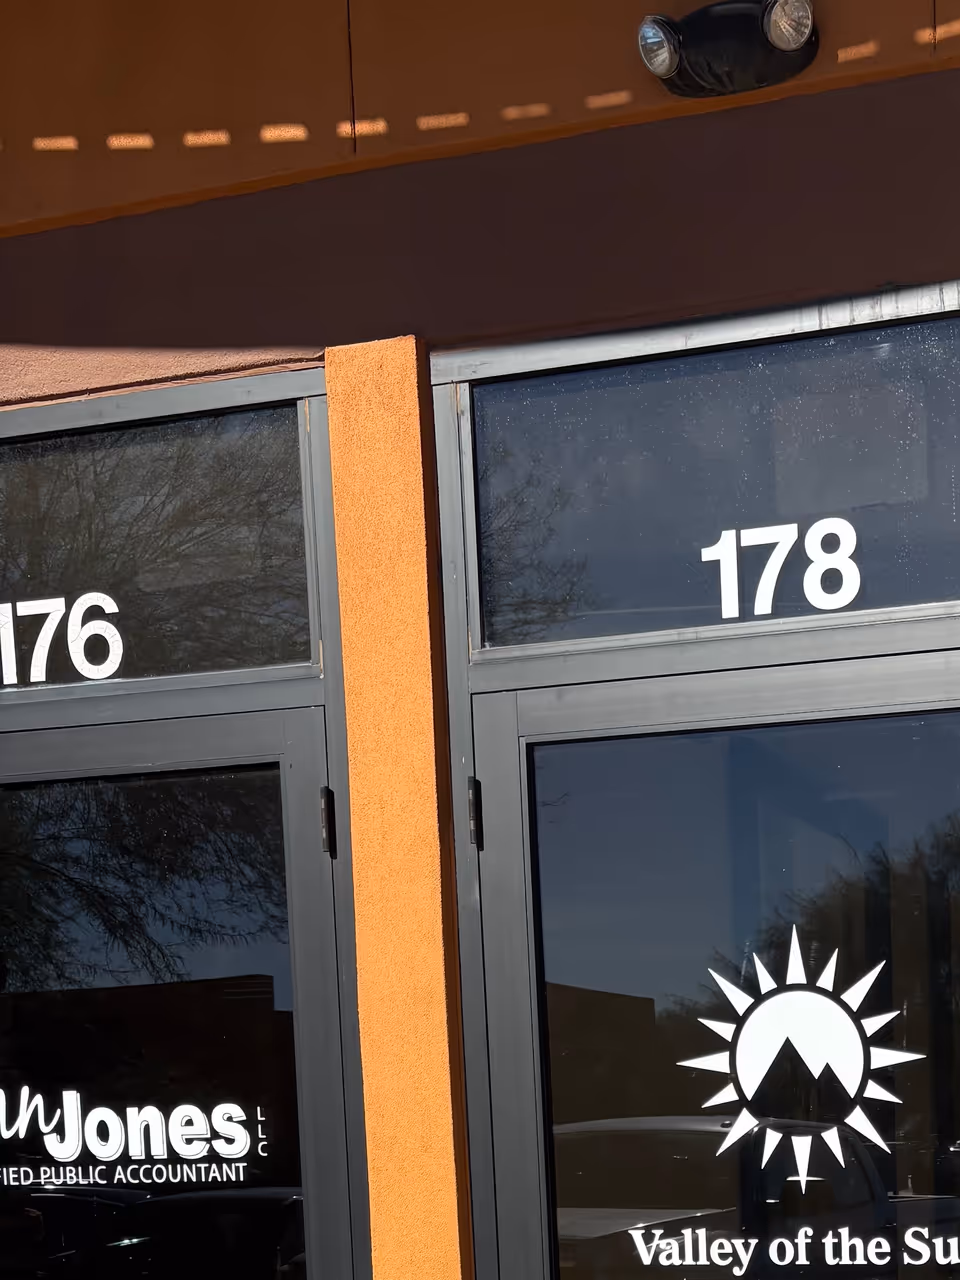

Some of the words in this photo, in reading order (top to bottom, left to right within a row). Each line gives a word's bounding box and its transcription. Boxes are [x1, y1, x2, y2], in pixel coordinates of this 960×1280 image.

[701, 517, 861, 619] 178
[0, 592, 124, 685] 176
[43, 1090, 251, 1163] Jones
[40, 1165, 108, 1185] PUBLIC
[113, 1162, 248, 1184] ACCOUNTANT
[627, 1226, 759, 1277] Valley
[768, 1226, 814, 1266] of
[821, 1226, 891, 1266] the
